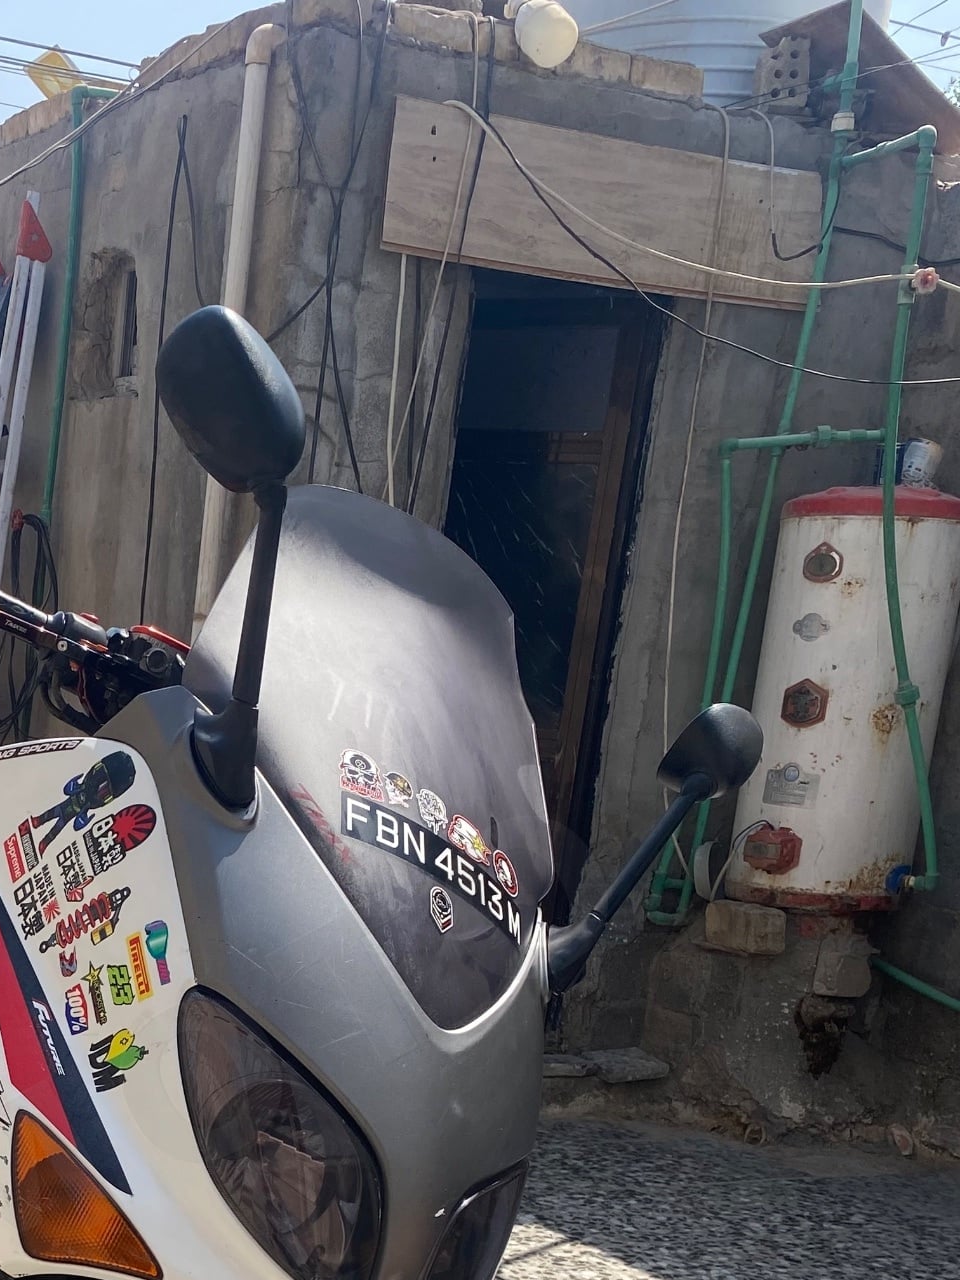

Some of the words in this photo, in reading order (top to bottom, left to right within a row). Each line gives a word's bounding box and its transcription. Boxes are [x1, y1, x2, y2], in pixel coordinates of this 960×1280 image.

[18, 740, 80, 755] SPORTS
[346, 797, 426, 864] FBN
[8, 836, 21, 878] Supreme
[41, 864, 53, 889] MADE
[14, 877, 46, 940] 日本製
[33, 871, 48, 906] JAPAN
[107, 964, 136, 1005] 23
[129, 935, 150, 995] PIRELLI
[66, 986, 89, 1032] 100%
